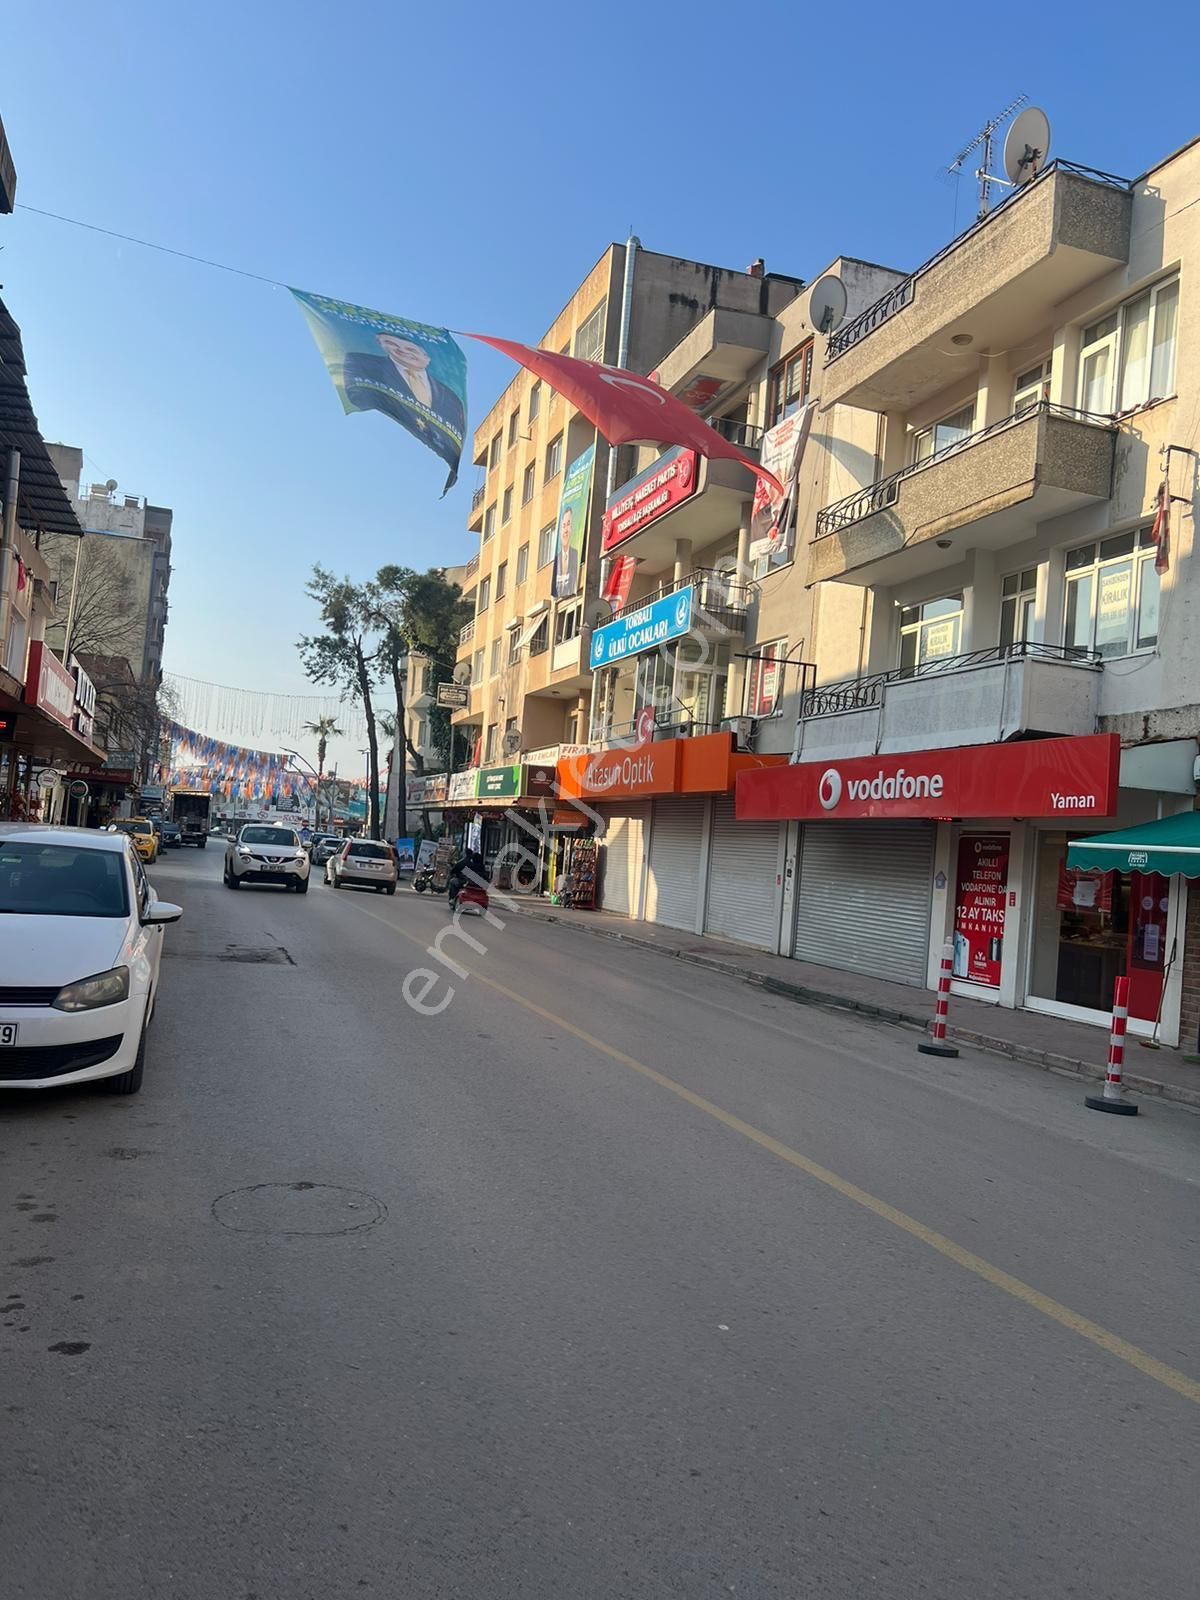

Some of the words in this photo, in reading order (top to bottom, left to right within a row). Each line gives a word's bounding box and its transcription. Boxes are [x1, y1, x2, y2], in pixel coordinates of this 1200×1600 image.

[625, 606, 653, 631] TORBALI
[608, 633, 627, 658] ÜLKÜ
[628, 619, 668, 650] OCAKLARI
[622, 754, 654, 791] Optik
[848, 768, 943, 800] vodafone
[1051, 793, 1095, 810] Yaman
[977, 858, 999, 868] AKILLI
[972, 870, 1001, 881] TELEFON
[974, 896, 996, 907] ALINIR
[956, 906, 967, 918] 12
[968, 907, 980, 919] AY
